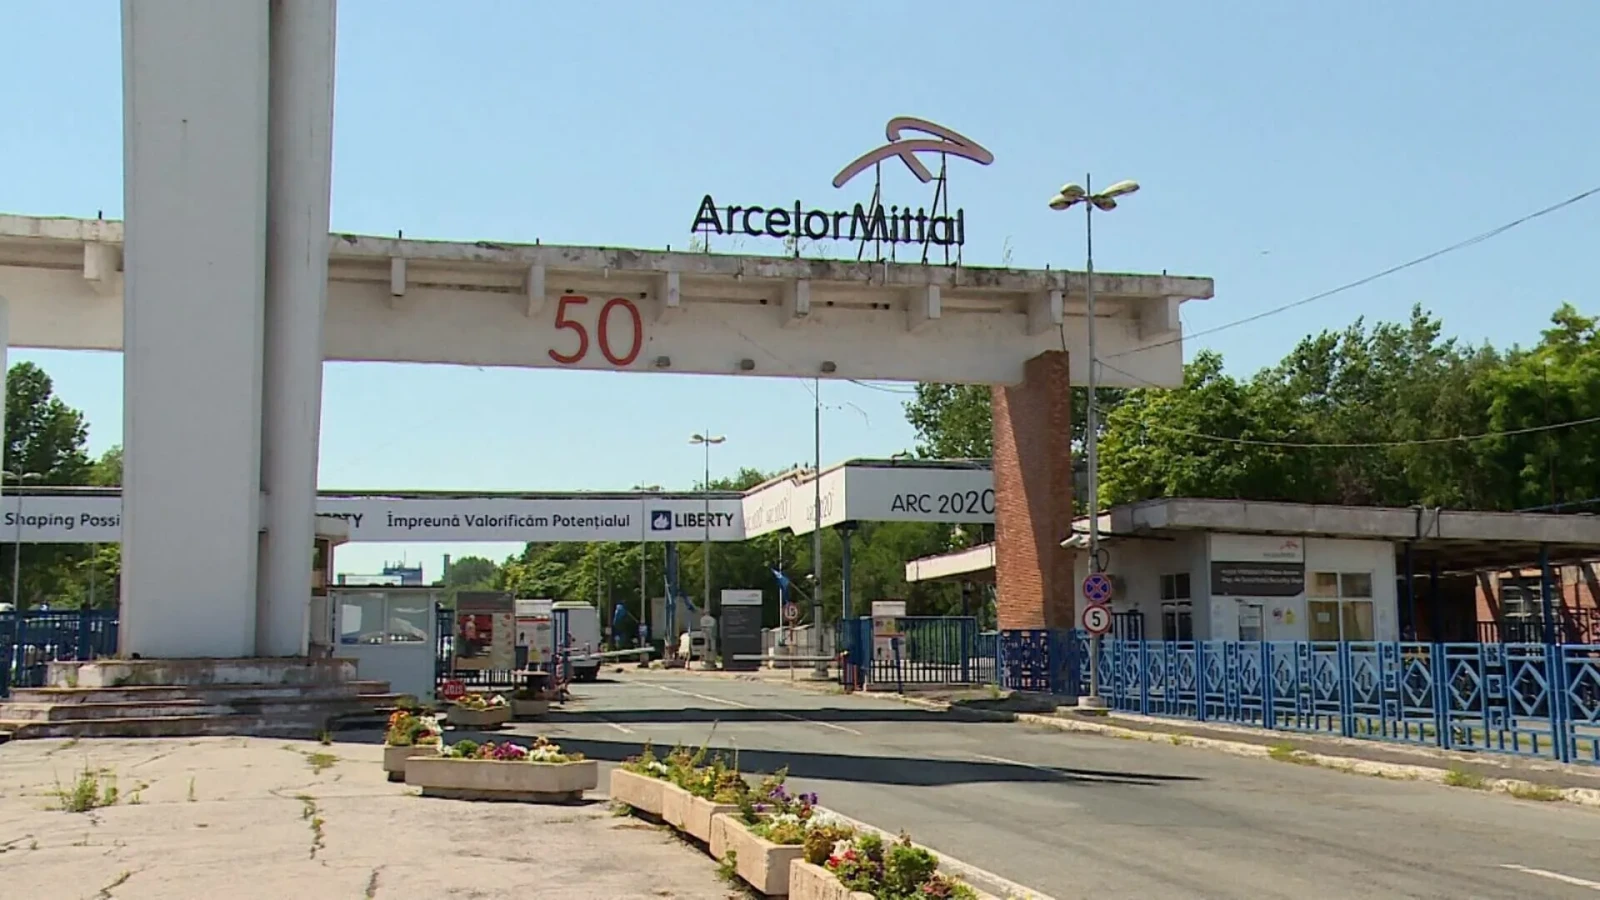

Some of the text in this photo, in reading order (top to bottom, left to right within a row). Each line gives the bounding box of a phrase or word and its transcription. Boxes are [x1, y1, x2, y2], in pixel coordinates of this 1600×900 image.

[691, 194, 965, 246] ArcelorMittal
[548, 295, 643, 367] 50
[890, 494, 931, 513] ARC
[4, 512, 75, 530] Shaping
[464, 514, 548, 528] Valorificăm
[552, 514, 630, 530] Potențialul
[675, 513, 733, 527] LIBERTY
[1092, 611, 1101, 627] 5
